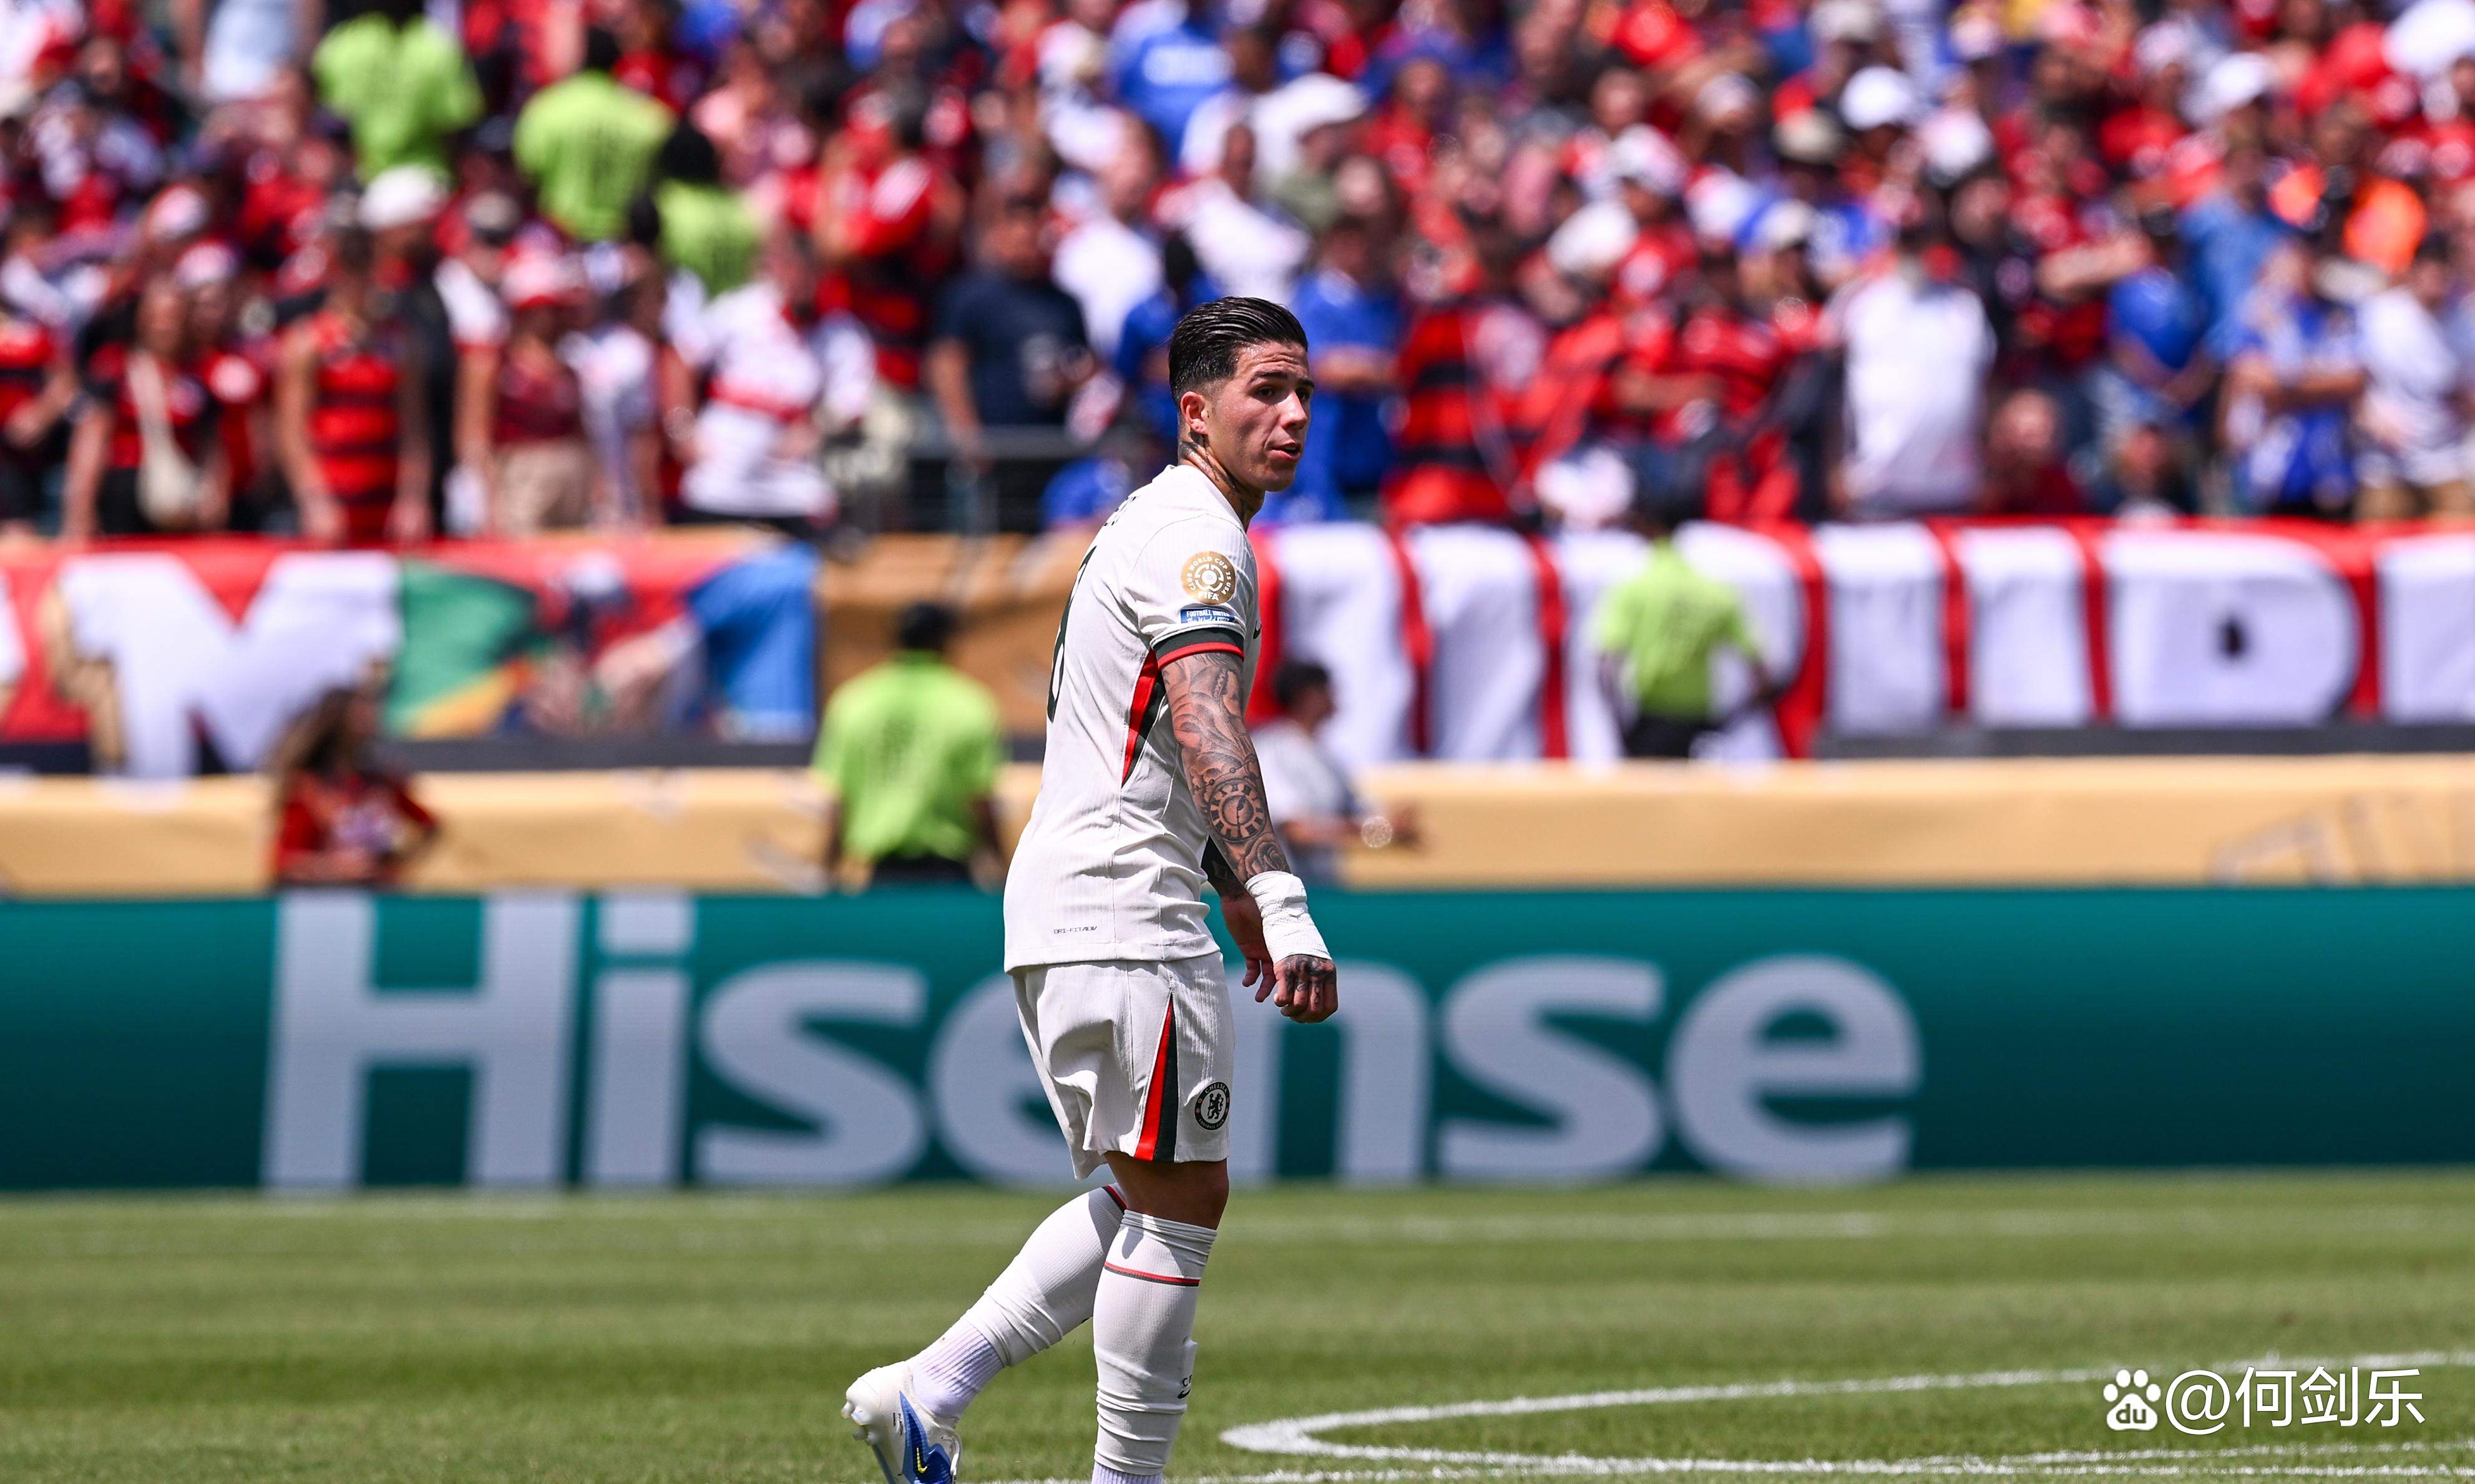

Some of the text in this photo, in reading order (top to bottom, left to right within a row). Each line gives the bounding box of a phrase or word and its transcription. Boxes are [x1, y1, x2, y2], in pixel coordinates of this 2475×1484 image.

[1187, 557, 1232, 595] CLUB WORLD CUP 25 USA
[1198, 590, 1219, 600] FIFA
[1186, 609, 1212, 617] FOOTBALL
[1205, 1083, 1228, 1093] CHELSEA
